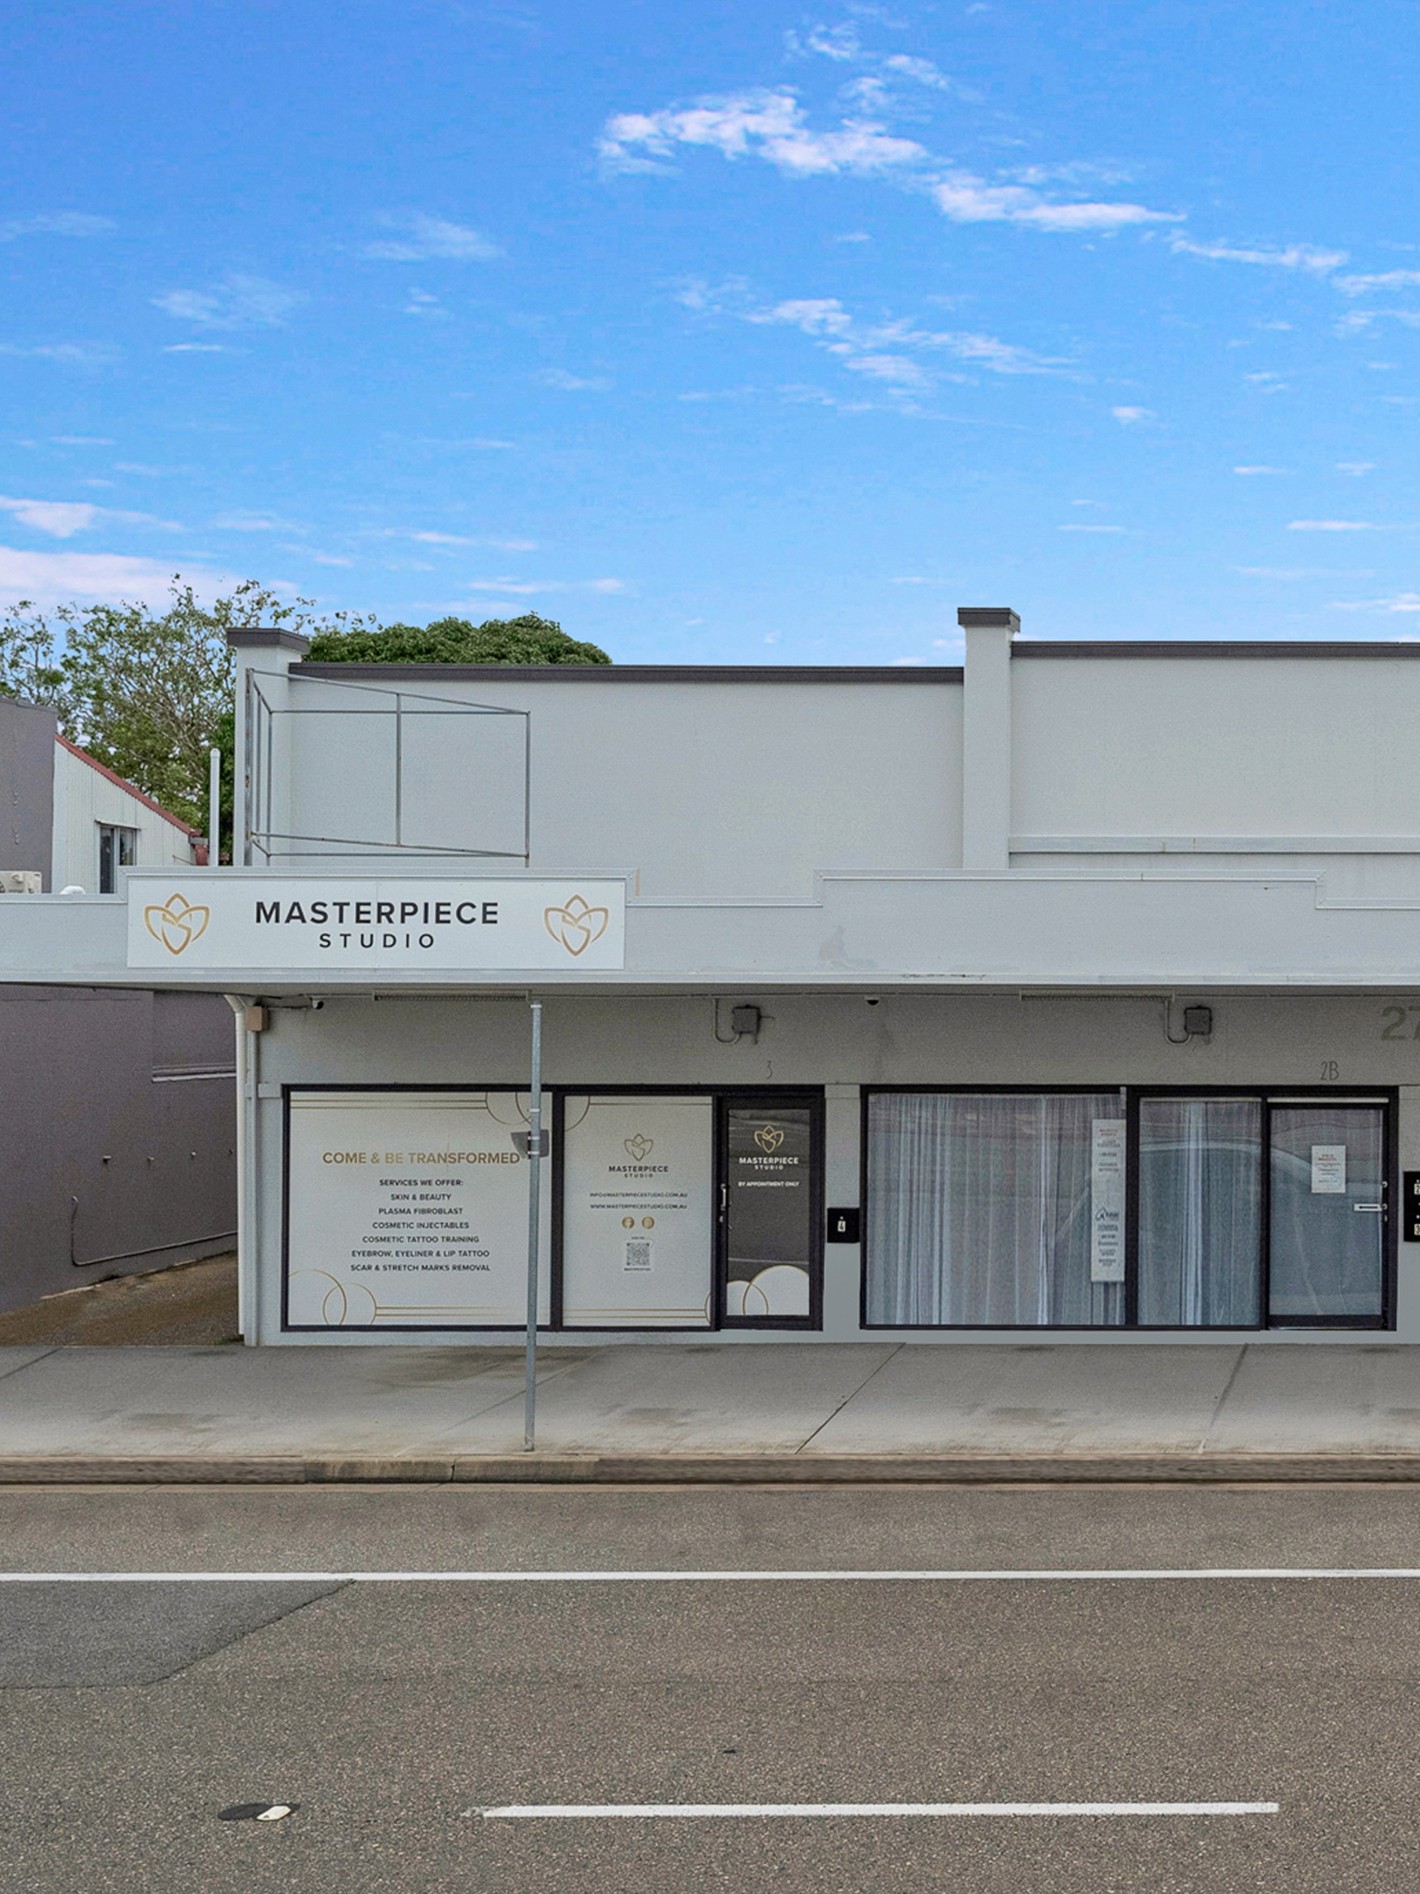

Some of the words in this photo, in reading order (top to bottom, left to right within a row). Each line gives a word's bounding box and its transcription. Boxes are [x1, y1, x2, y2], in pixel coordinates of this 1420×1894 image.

[255, 901, 499, 925] MASTERPIECE
[318, 933, 435, 949] STUDIO
[1320, 1060, 1339, 1081] 2B
[322, 1152, 367, 1164] COME
[370, 1152, 381, 1164] &
[385, 1152, 403, 1164] BE
[408, 1152, 520, 1164] TRANSFORMED
[738, 1157, 799, 1165] MASTERPIECE
[608, 1165, 669, 1173] MASTERPIECE
[379, 1179, 418, 1187] SERVICES
[420, 1179, 433, 1187] WE
[435, 1179, 464, 1187] OFFER:
[390, 1193, 409, 1201] SKIN
[411, 1193, 417, 1201] &
[419, 1193, 451, 1201] BEAUTY
[378, 1207, 411, 1215] PLASMA
[413, 1207, 463, 1215] FIBROBLAST
[351, 1250, 394, 1258] EYEBROW,
[395, 1250, 434, 1258] EYELINER
[435, 1250, 442, 1258] &
[443, 1250, 456, 1258] LIP
[458, 1250, 490, 1258] TATTOO
[350, 1264, 373, 1272] SCAR
[374, 1264, 381, 1272] &
[382, 1264, 419, 1272] STRETCH
[421, 1264, 450, 1272] MARKS
[451, 1264, 491, 1272] REMOVAL
